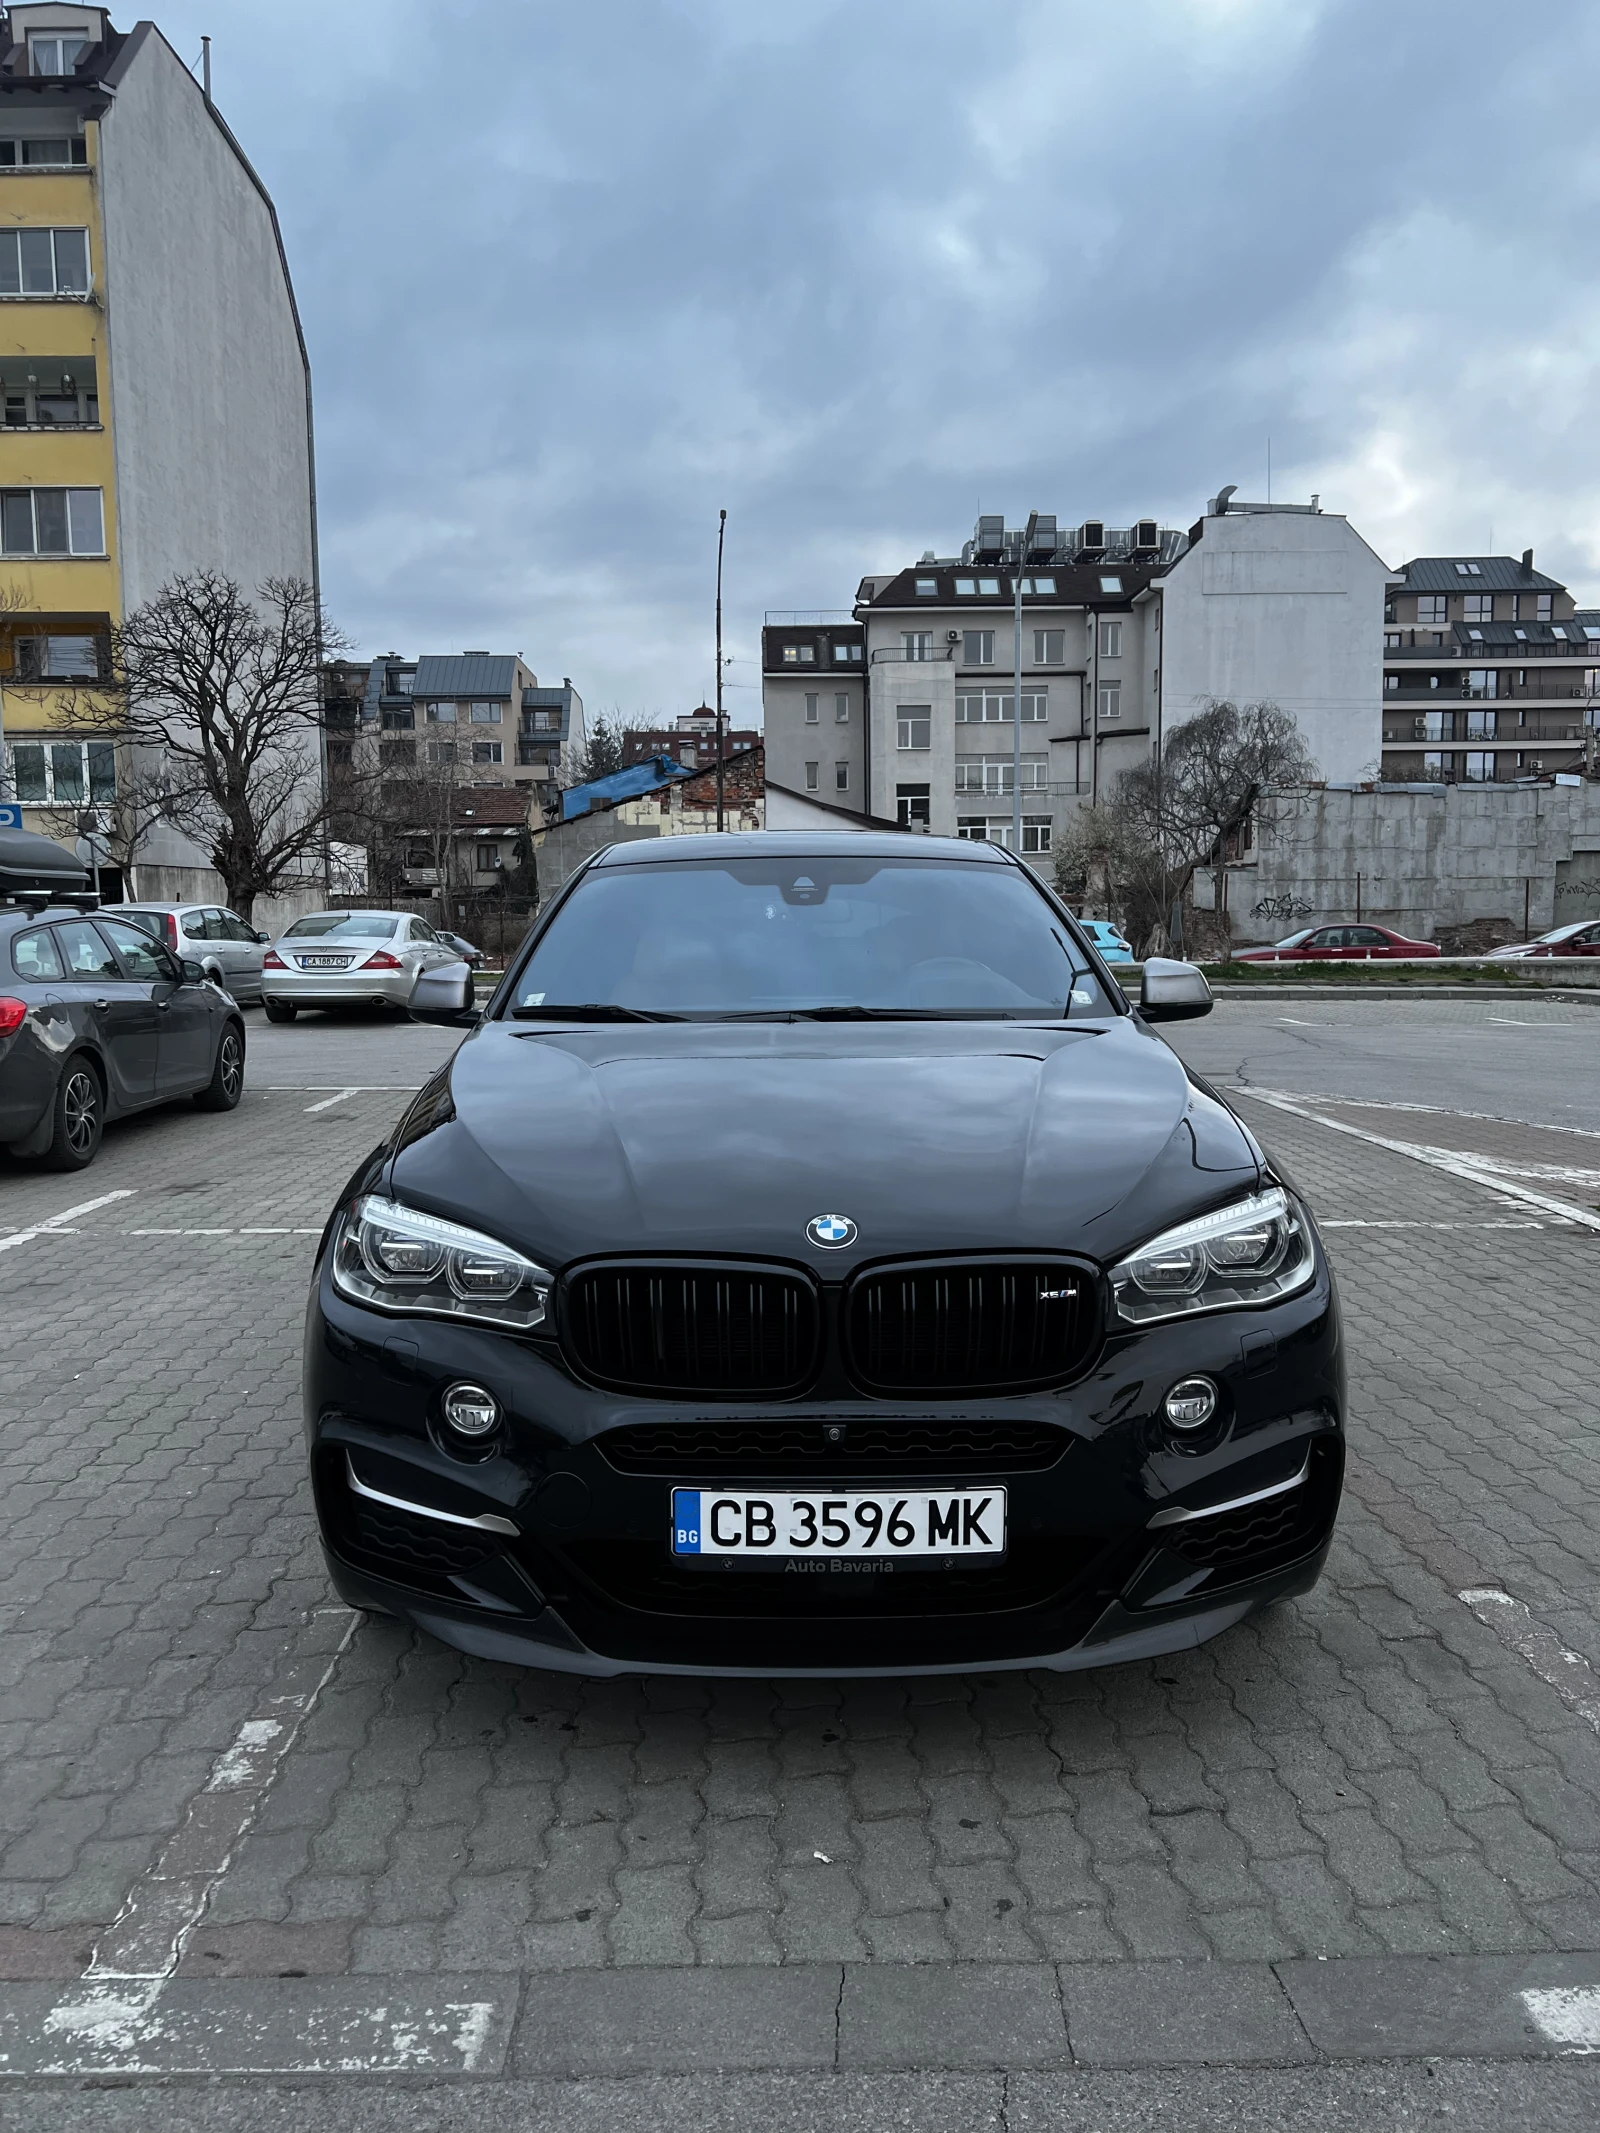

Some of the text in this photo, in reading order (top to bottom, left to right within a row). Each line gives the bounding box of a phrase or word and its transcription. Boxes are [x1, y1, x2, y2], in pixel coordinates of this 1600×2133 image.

[710, 1497, 993, 1548] CB 3596 MK
[677, 1529, 699, 1544] BG
[784, 1559, 894, 1573] Auto Bavaria
